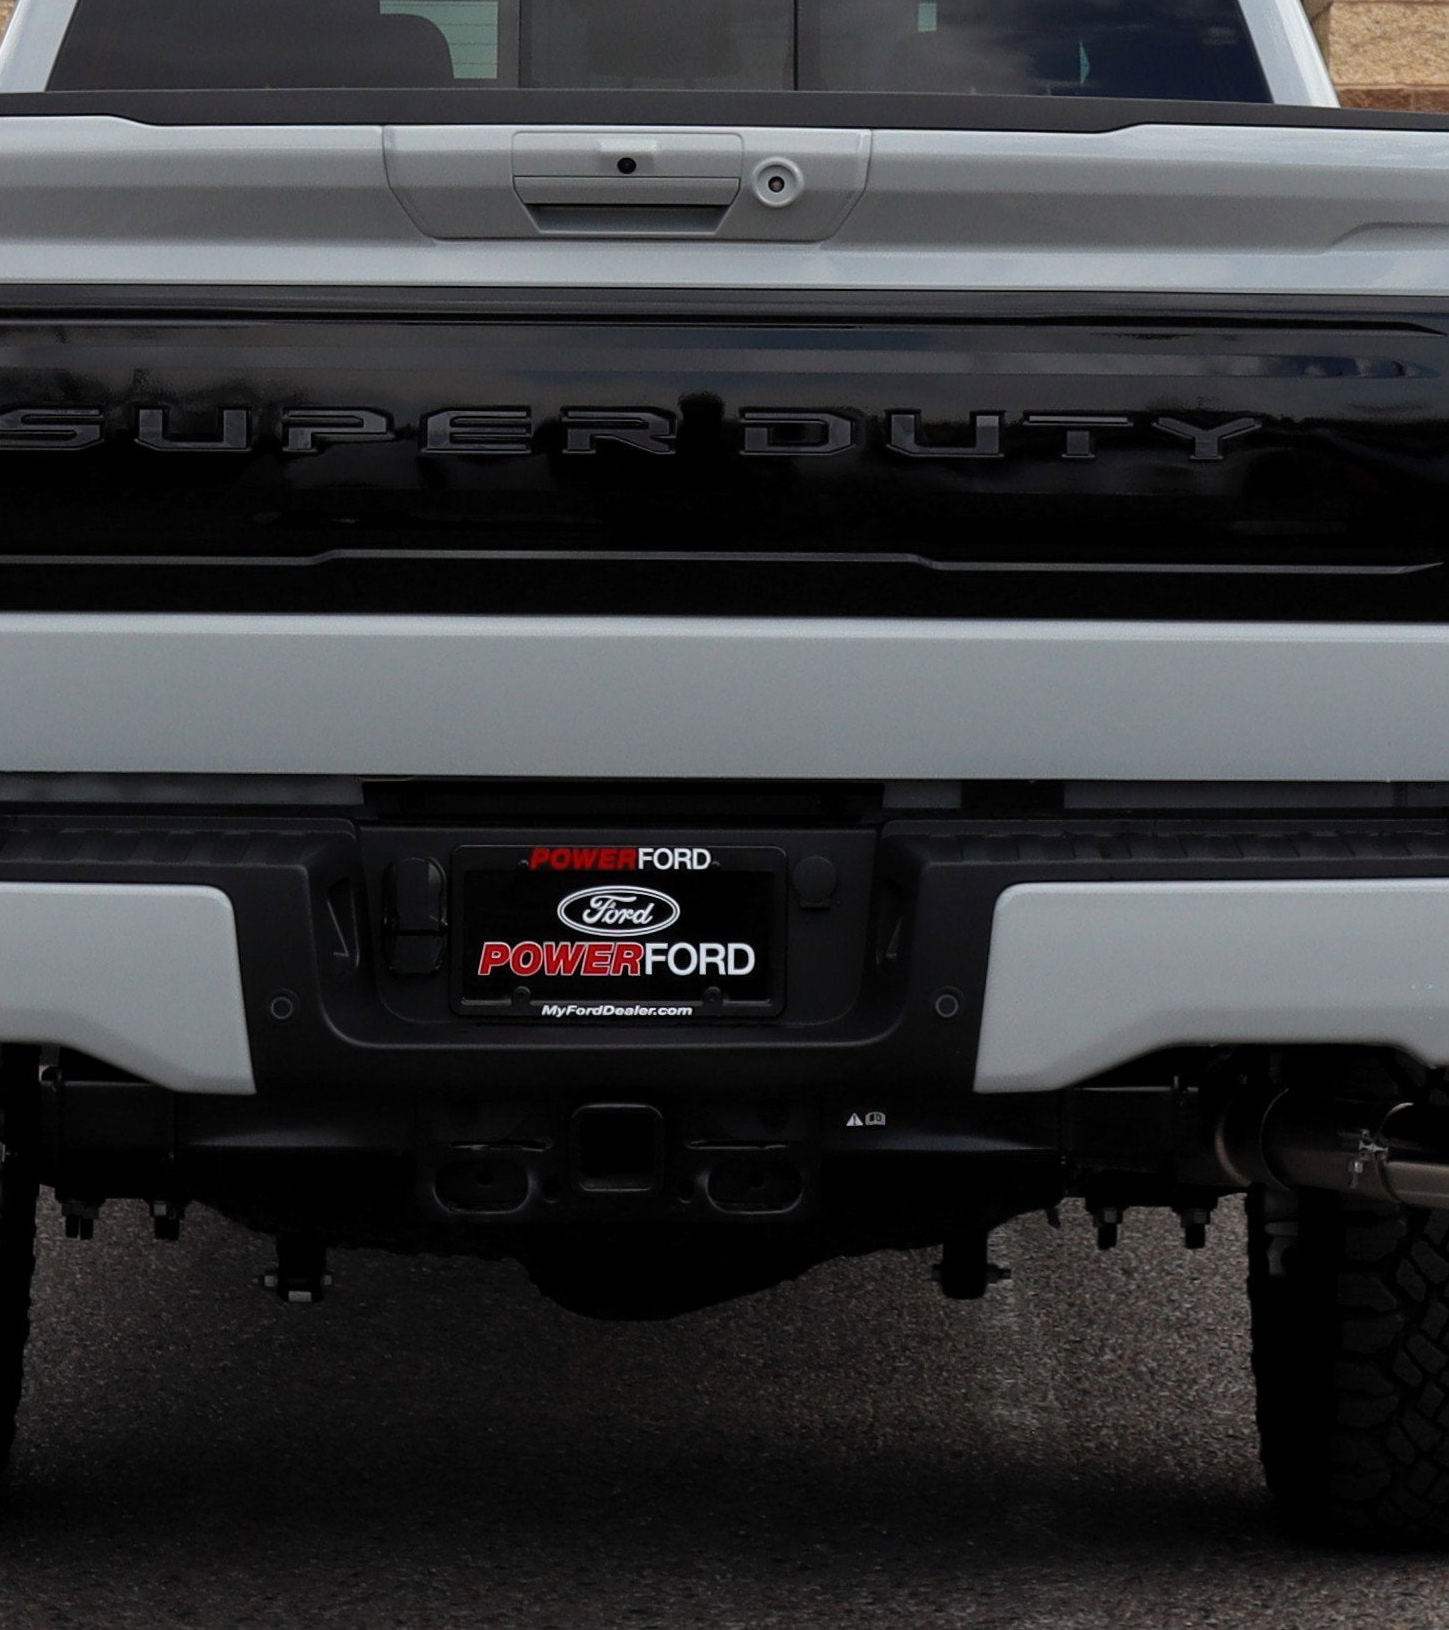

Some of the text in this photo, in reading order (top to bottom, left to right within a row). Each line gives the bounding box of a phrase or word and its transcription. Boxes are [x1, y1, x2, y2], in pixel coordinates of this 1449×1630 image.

[738, 406, 1265, 461] DUTY
[582, 894, 655, 925] Ford
[541, 1005, 693, 1018] MyFordDealer.com
